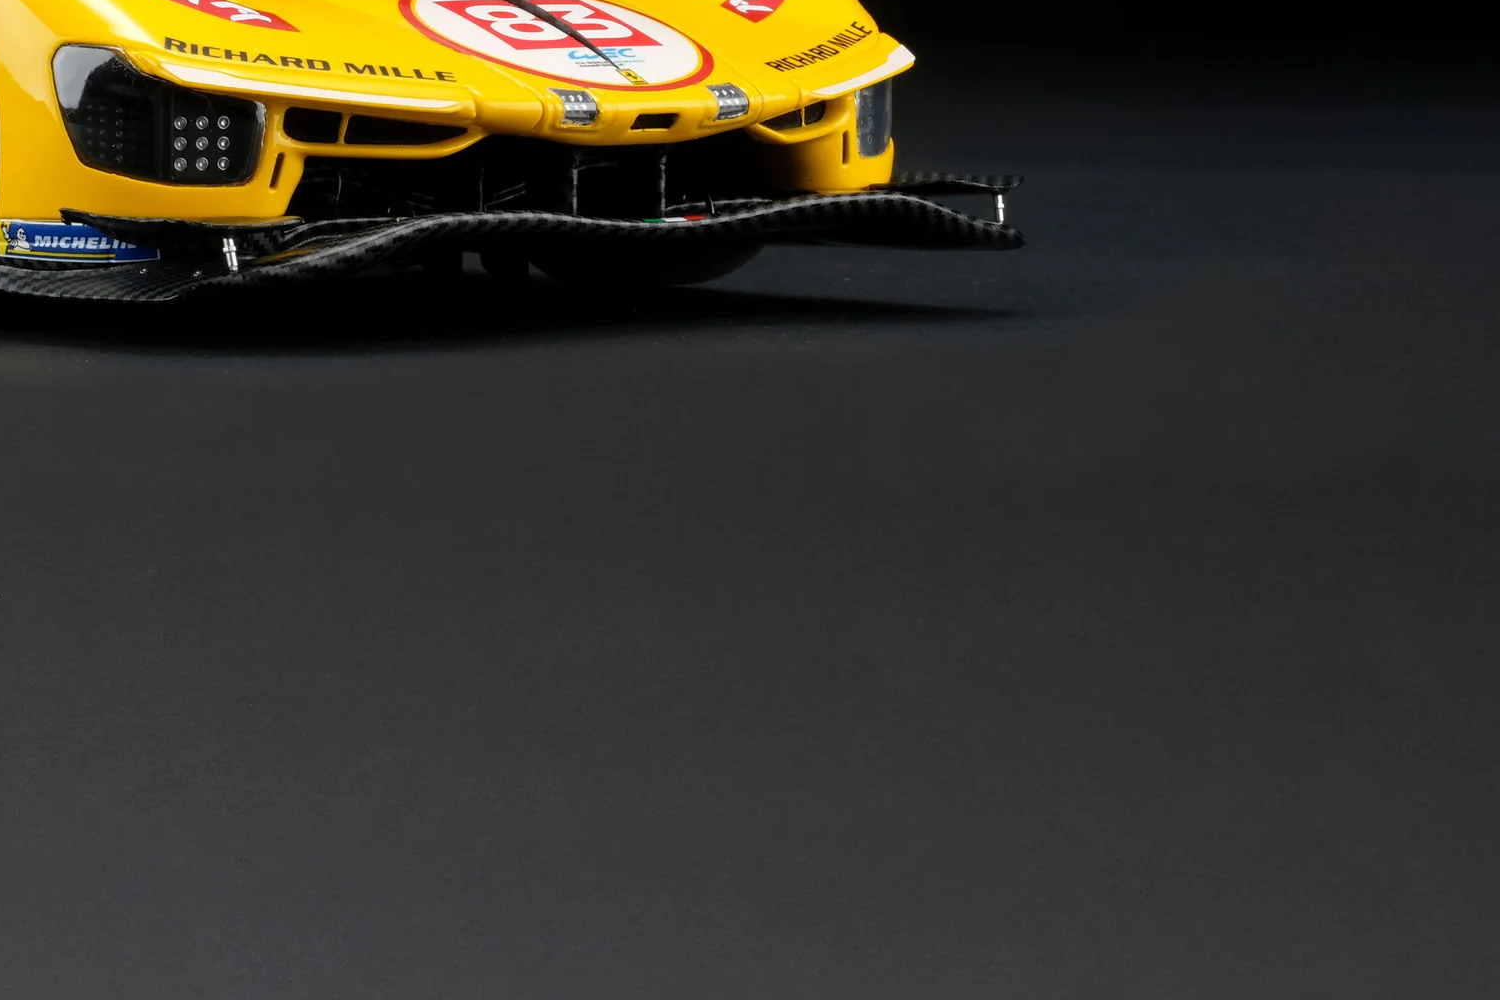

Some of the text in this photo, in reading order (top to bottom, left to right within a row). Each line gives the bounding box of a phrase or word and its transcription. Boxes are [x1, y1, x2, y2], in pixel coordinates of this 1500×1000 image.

[465, 3, 633, 41] 83
[164, 36, 457, 82] RICHARD MILLE
[764, 21, 873, 72] RICHARD MILLE
